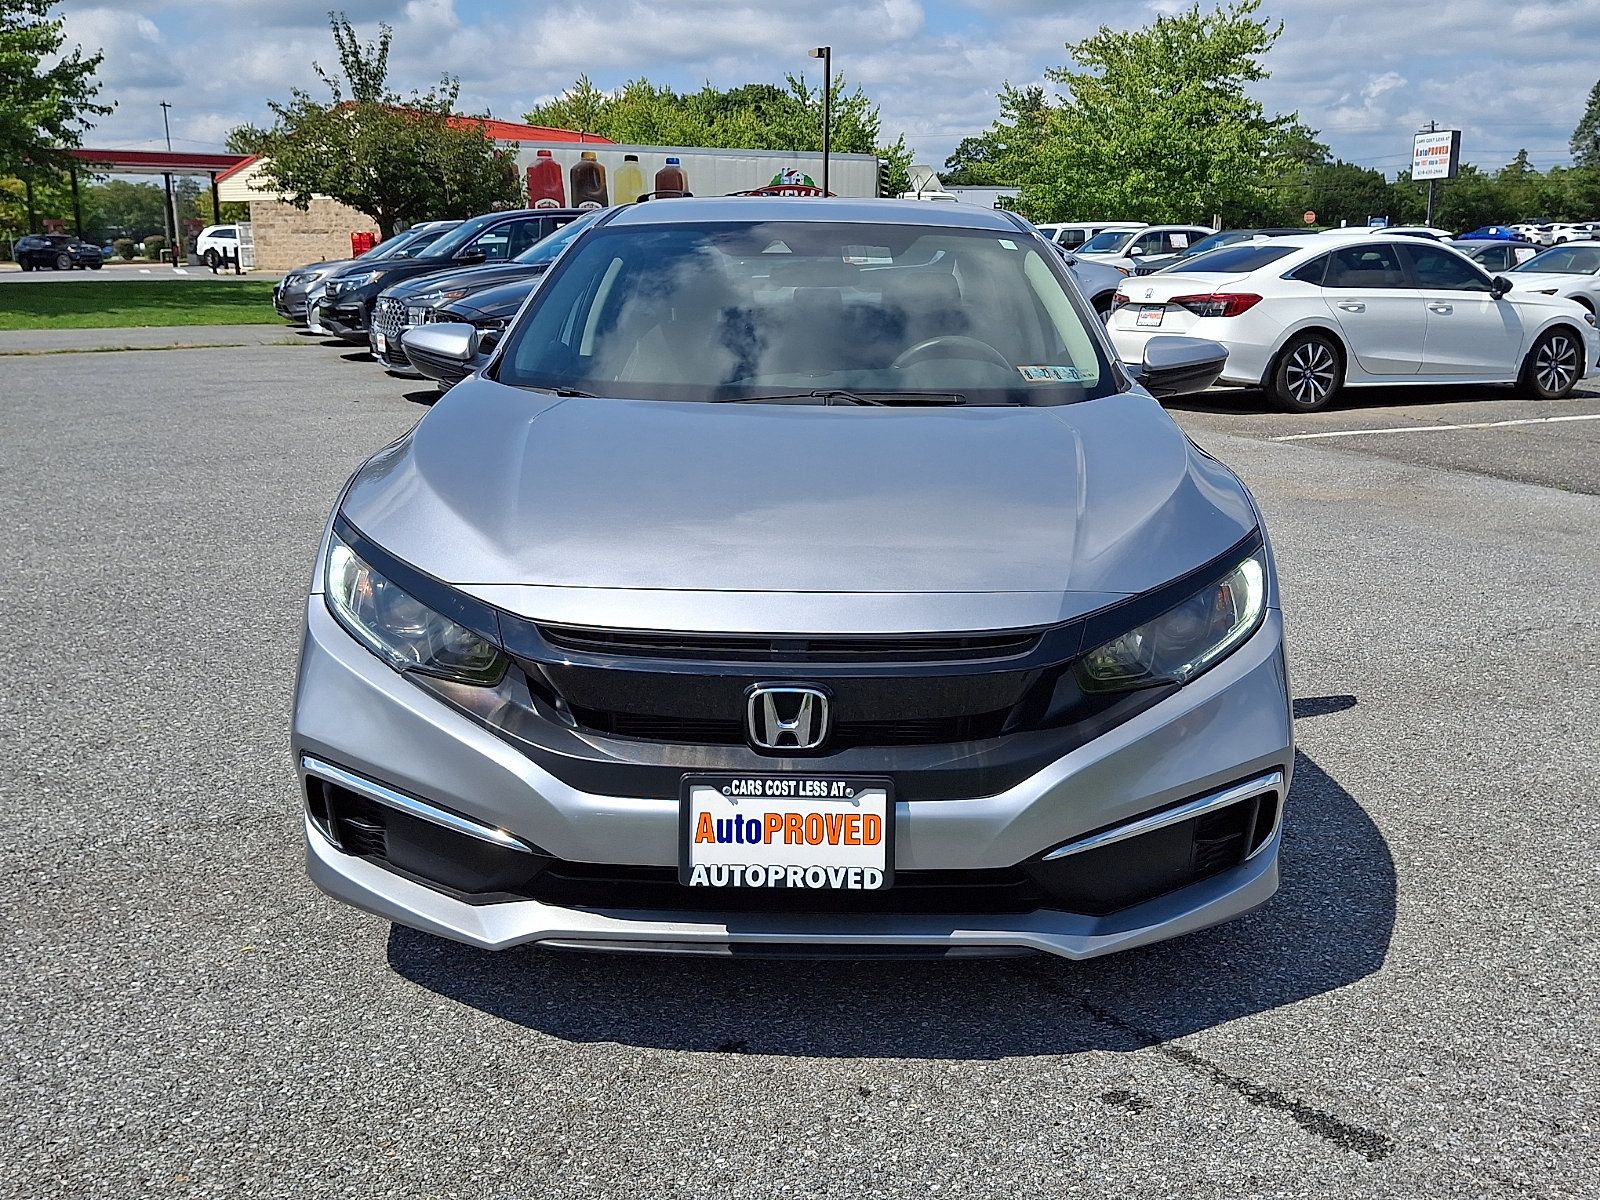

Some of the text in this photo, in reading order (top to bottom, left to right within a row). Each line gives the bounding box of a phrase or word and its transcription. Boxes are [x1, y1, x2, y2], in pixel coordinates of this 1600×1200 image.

[731, 779, 846, 797] CARS COST LESS AT
[694, 812, 882, 845] AutoPROVED
[689, 863, 884, 890] AUTOPROVED
